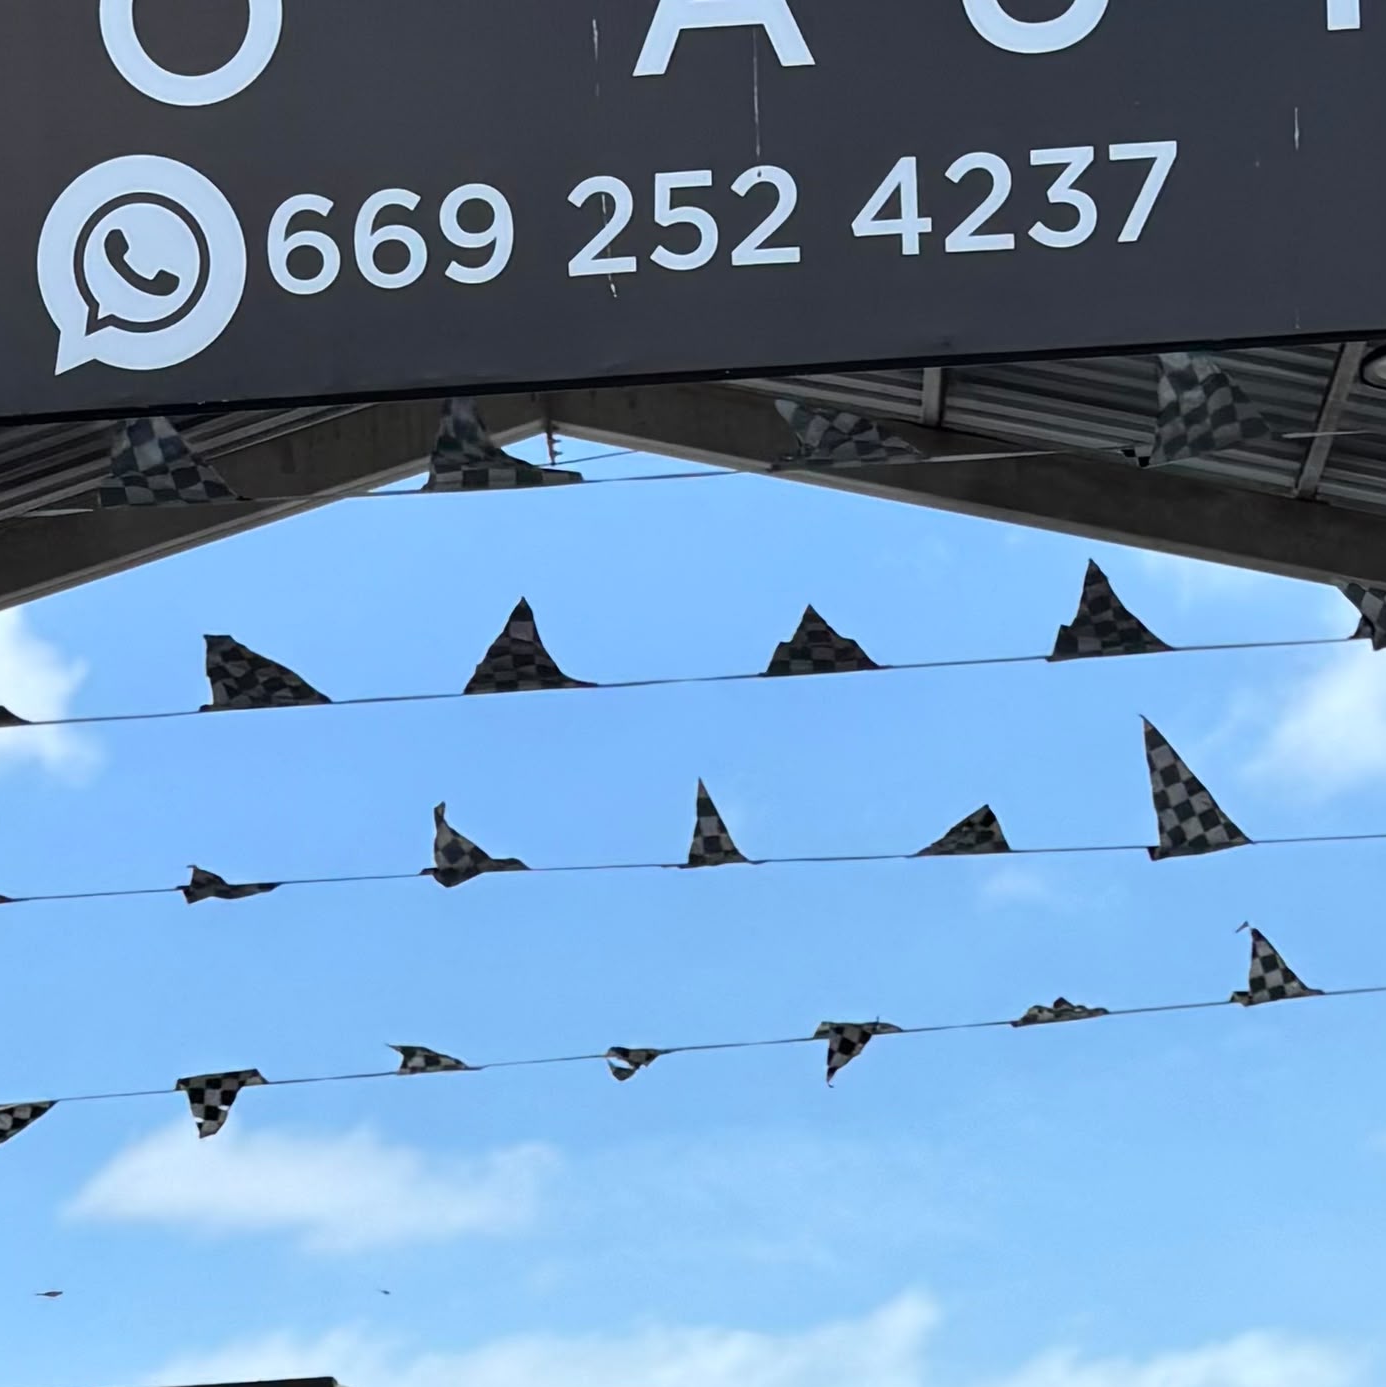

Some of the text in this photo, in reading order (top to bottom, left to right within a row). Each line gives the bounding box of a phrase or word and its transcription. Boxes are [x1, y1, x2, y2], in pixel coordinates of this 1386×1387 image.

[267, 140, 1177, 295] 669 252 4237
